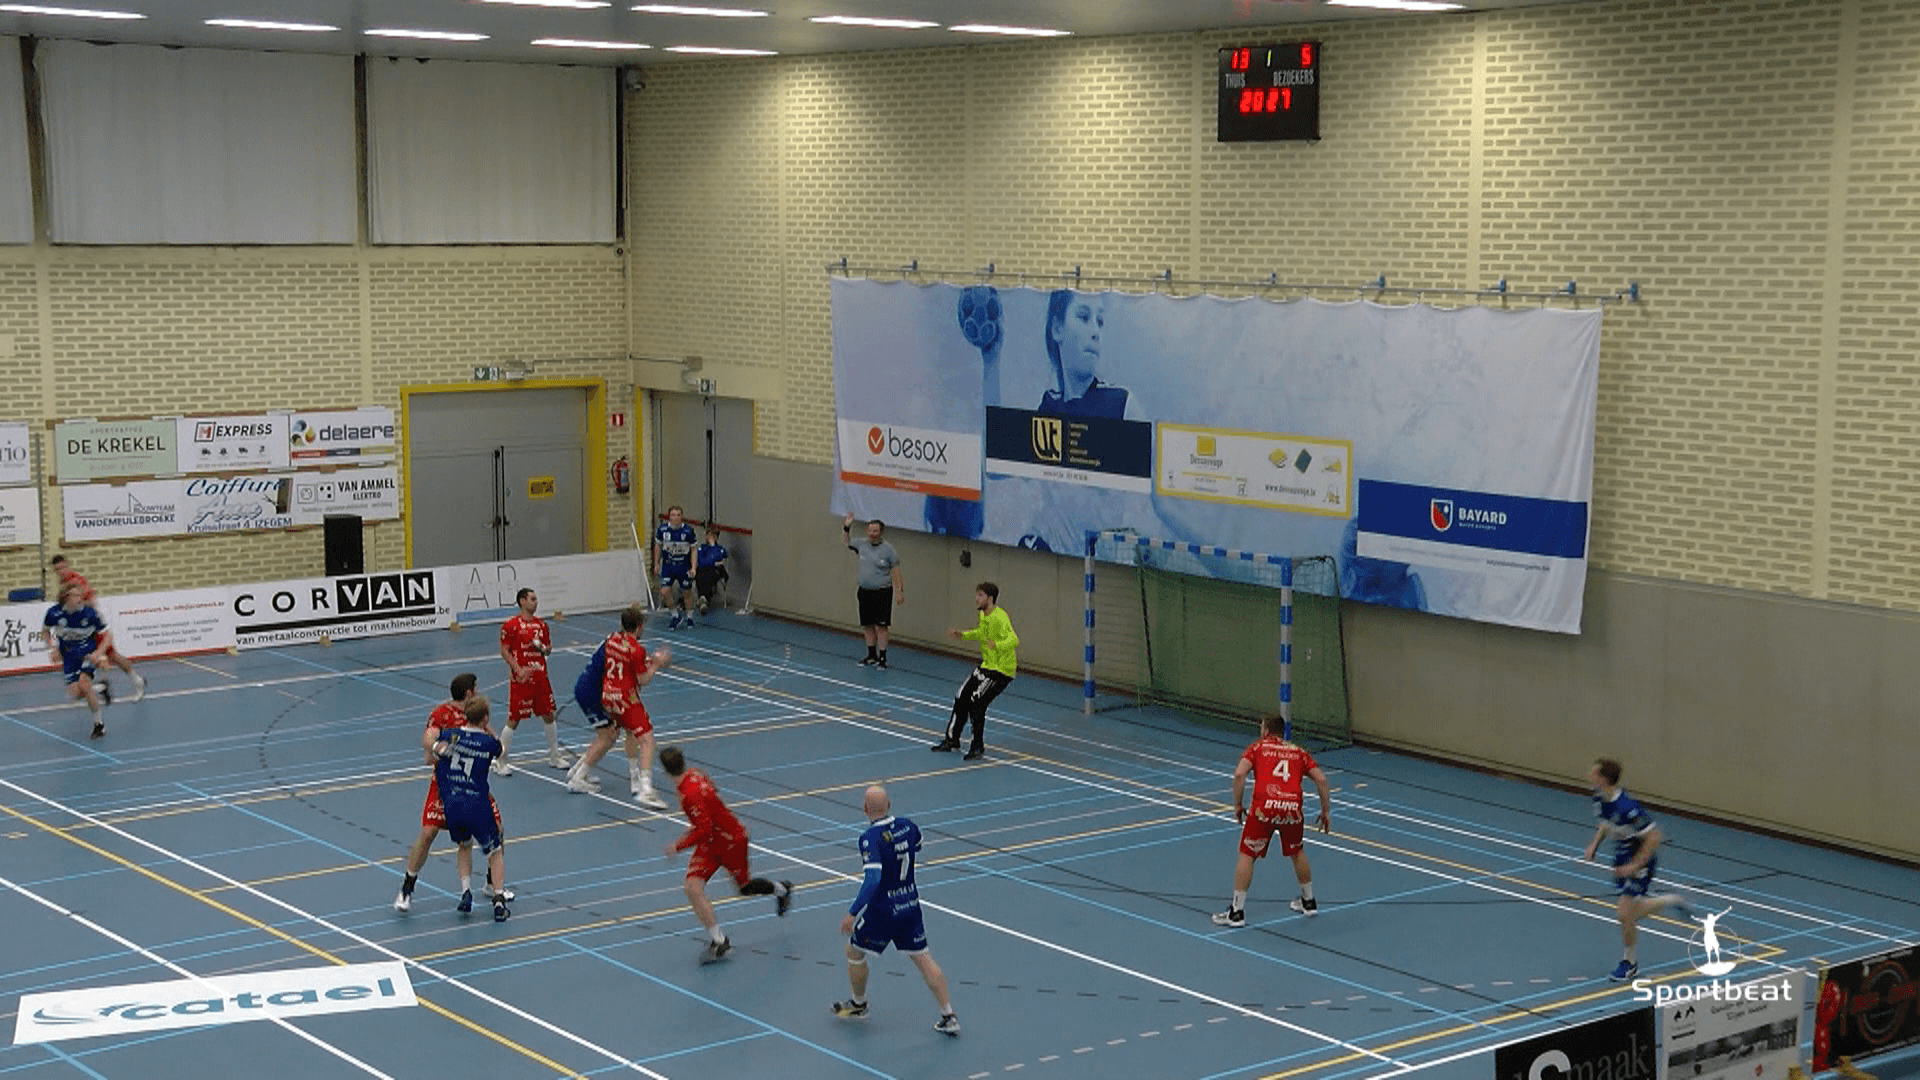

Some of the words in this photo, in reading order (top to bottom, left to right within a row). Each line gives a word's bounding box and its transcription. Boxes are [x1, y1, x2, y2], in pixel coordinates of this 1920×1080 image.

[1231, 48, 1250, 71] 13
[1301, 43, 1312, 68] 5
[1225, 72, 1246, 88] THUIS
[1273, 69, 1315, 87] BEZOEKERS
[216, 423, 272, 437] EXPRESS
[319, 424, 394, 441] delaere
[67, 439, 91, 455] DE
[97, 436, 166, 453] KREKEL
[888, 427, 948, 465] besox
[338, 481, 358, 492] VAN
[361, 478, 395, 490] AMMEL
[353, 491, 382, 500] ELEKTRO
[75, 514, 176, 529] VANDEMEULEBROEKE
[243, 520, 250, 528] 4
[255, 518, 292, 528] IZEGEM
[1458, 507, 1507, 525] BAYARD
[234, 576, 431, 617] CORVAN
[236, 636, 255, 645] van
[258, 626, 351, 643] metaalconstructie
[353, 623, 368, 634] tot
[370, 617, 437, 631] machinebouw
[606, 657, 624, 680] 21
[1272, 760, 1291, 782] 4
[897, 852, 910, 881] 7
